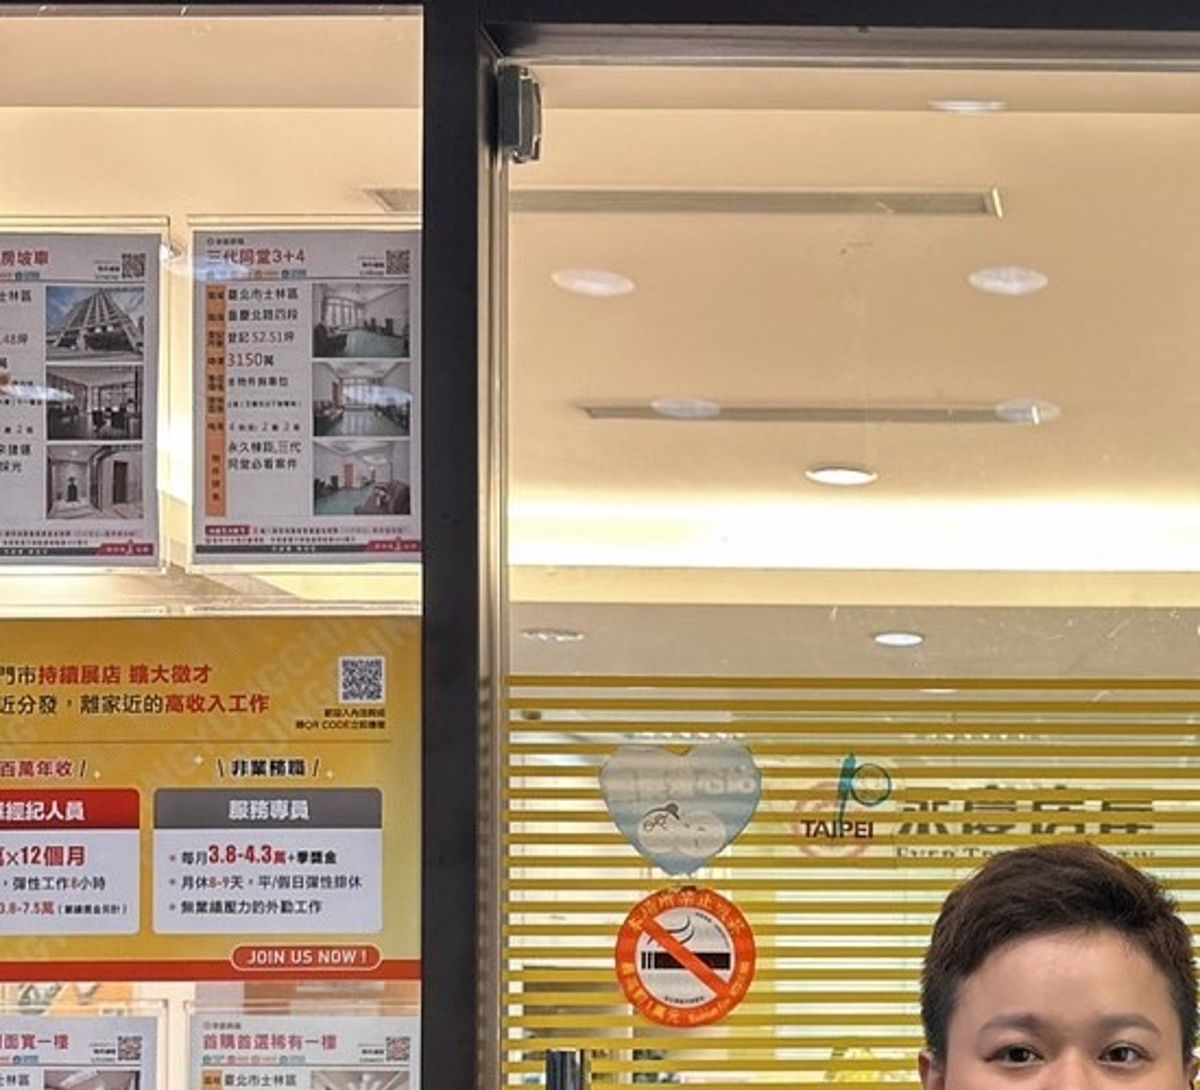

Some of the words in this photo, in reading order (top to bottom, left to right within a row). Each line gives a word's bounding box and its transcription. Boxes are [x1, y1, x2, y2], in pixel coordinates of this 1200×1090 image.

[207, 250, 306, 265] 三代同堂3+4
[227, 352, 274, 367] 3150萬
[129, 665, 213, 684] 擴大徵才
[229, 800, 310, 820] 服務專員
[800, 820, 874, 839] TAIPEI
[248, 950, 285, 965] JOIN
[291, 950, 313, 965] US
[0, 1034, 68, 1049] 面寬一樓
[203, 1034, 338, 1050] 首購首選稀有一樓
